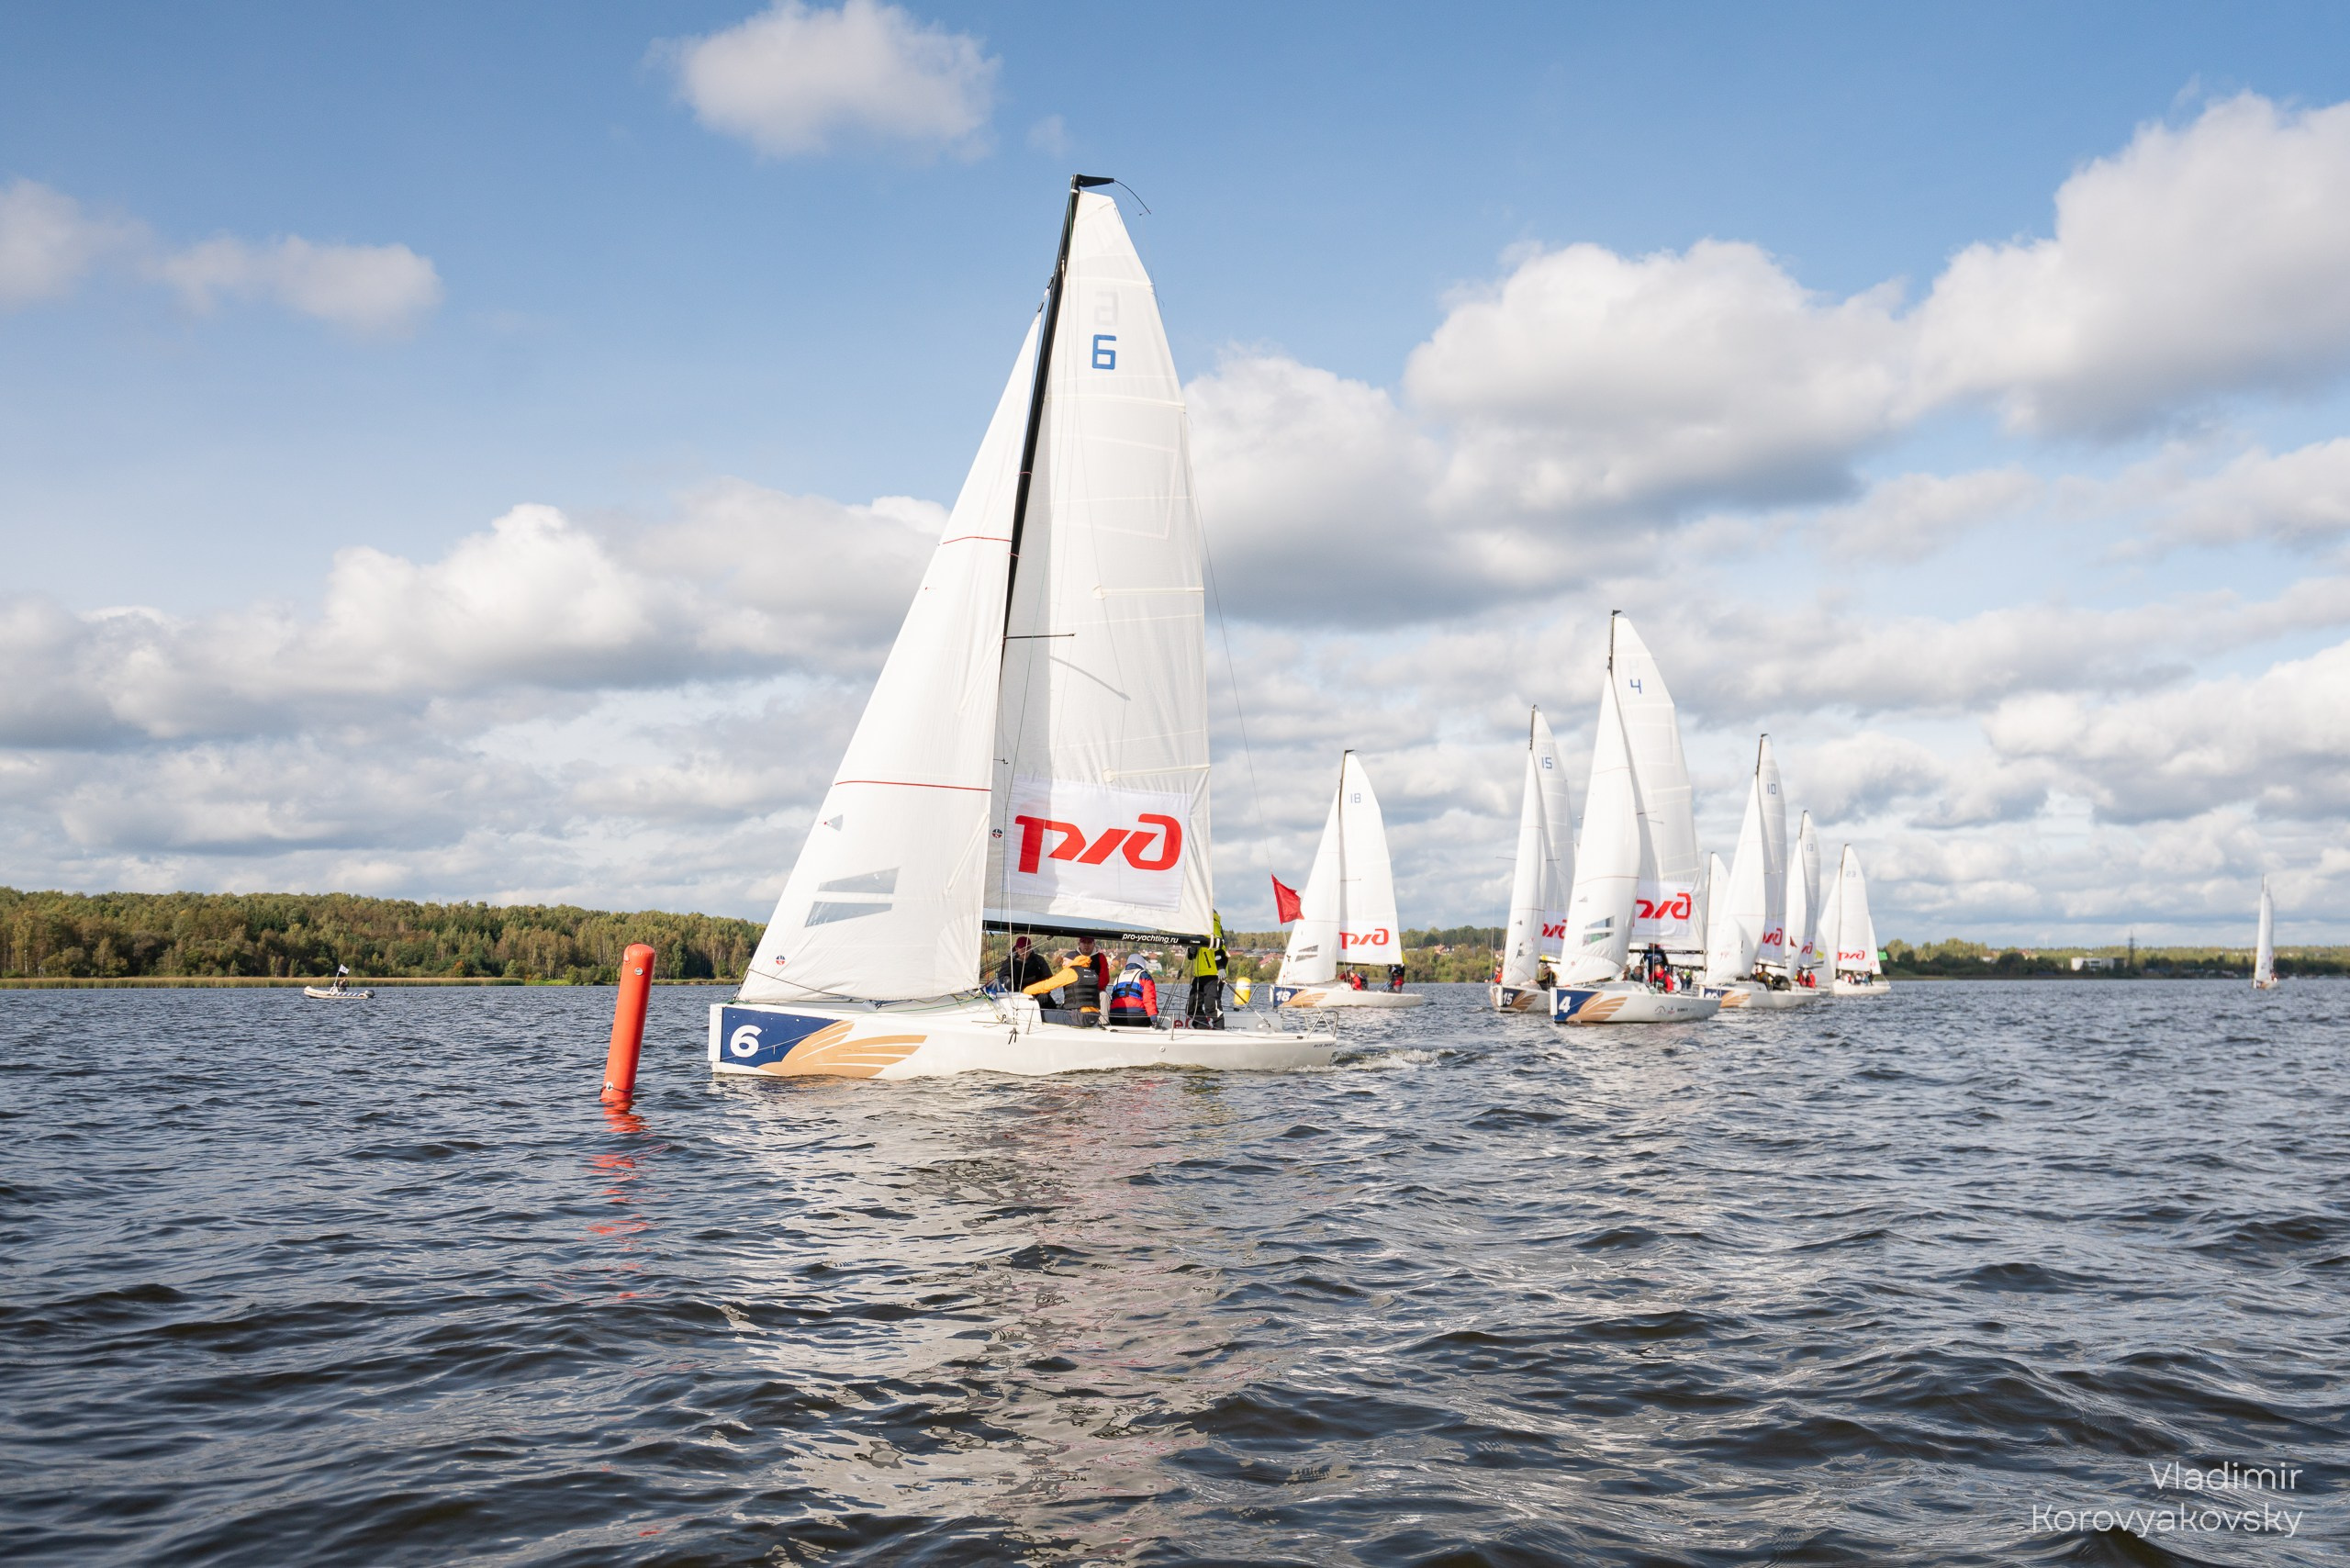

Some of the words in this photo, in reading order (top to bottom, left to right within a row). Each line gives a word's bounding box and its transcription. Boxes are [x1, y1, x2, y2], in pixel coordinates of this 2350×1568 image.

[1092, 334, 1117, 370] 6
[1629, 678, 1641, 694] 4
[1541, 756, 1552, 769] 15
[1767, 783, 1776, 795] 10
[1350, 792, 1361, 803] 18
[1122, 933, 1180, 945] pro-yachting.ru
[1276, 991, 1291, 1002] 18
[1503, 993, 1513, 1005] 15
[1559, 996, 1571, 1013] 4
[730, 1025, 762, 1058] 6
